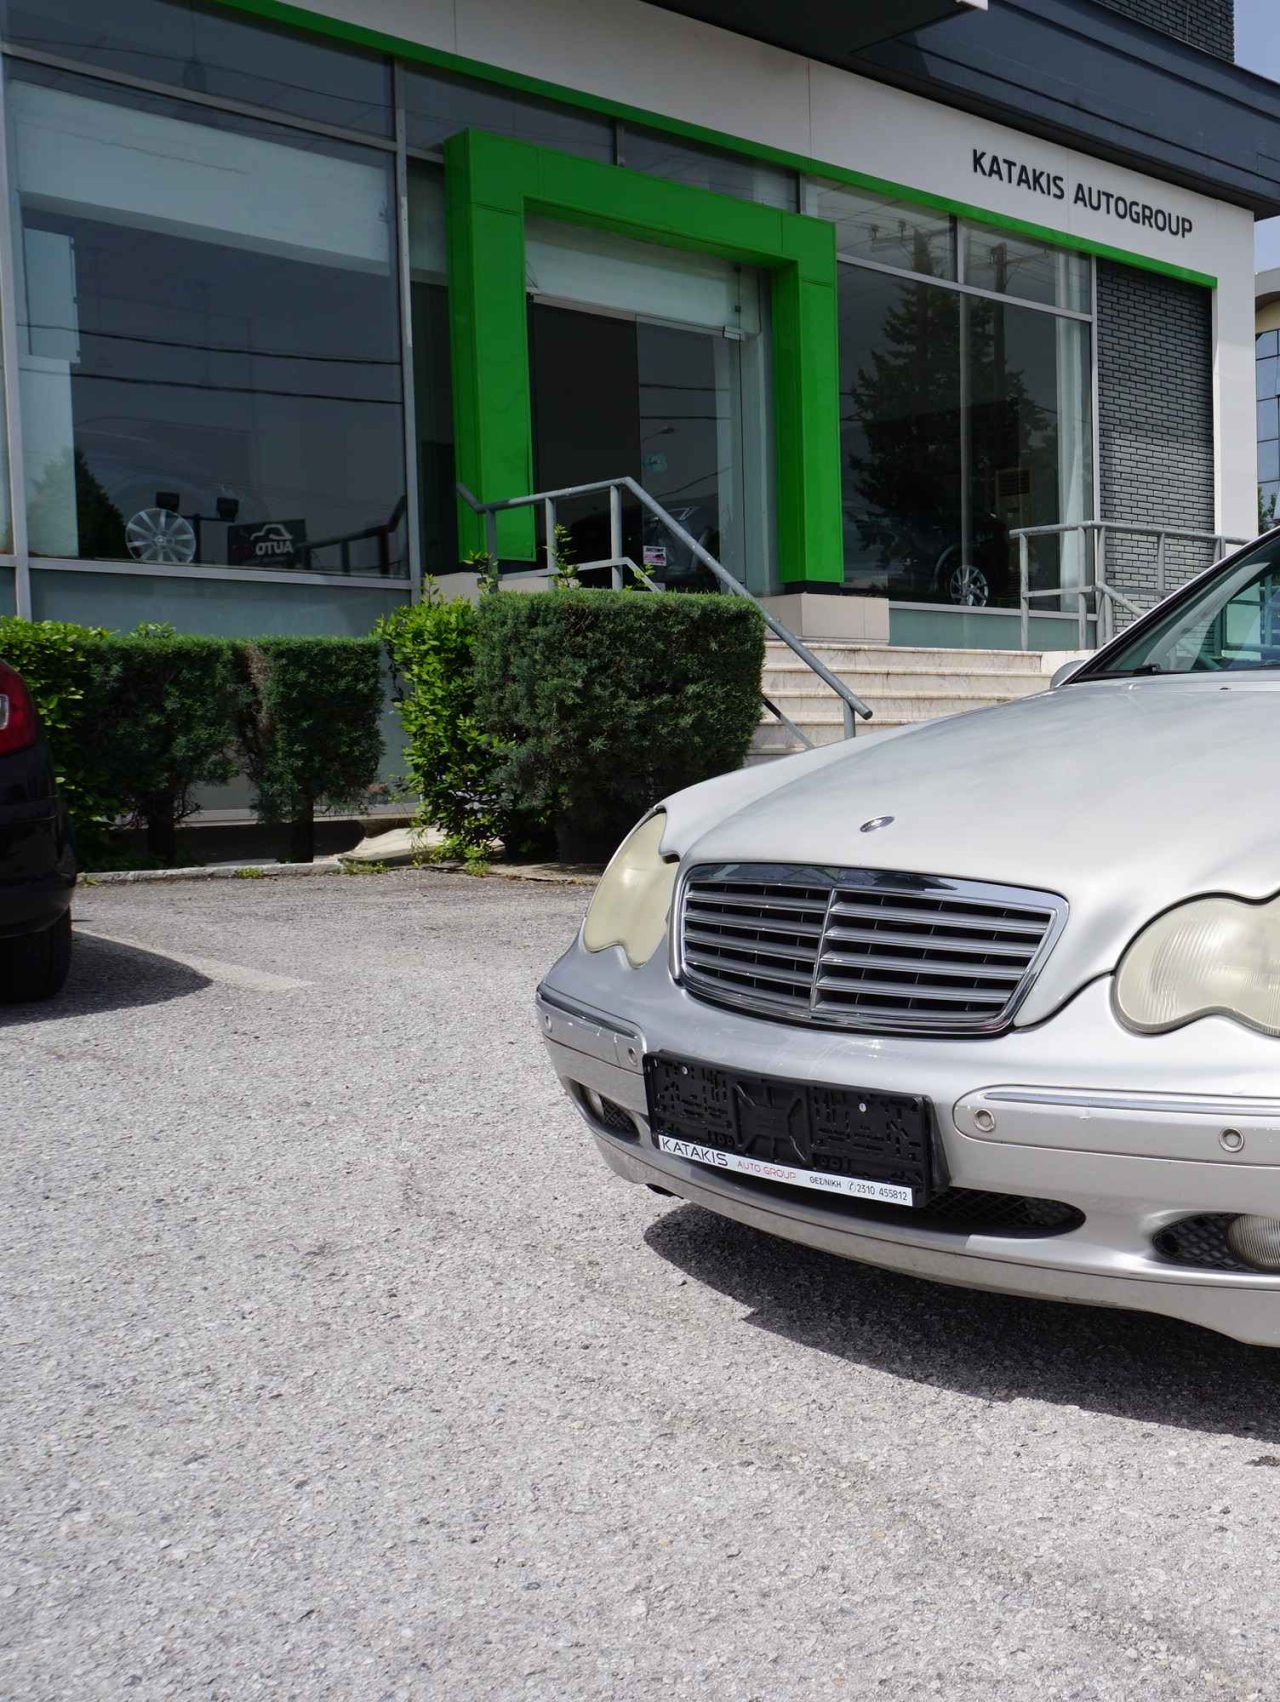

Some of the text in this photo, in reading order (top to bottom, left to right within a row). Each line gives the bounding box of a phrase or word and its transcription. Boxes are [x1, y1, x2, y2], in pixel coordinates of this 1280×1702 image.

[972, 148, 1193, 238] KATAKIS AUTOGROUP
[661, 1137, 797, 1181] KATAKIS AUTO GROUP
[857, 1183, 876, 1196] 2310
[878, 1187, 908, 1201] 455812
